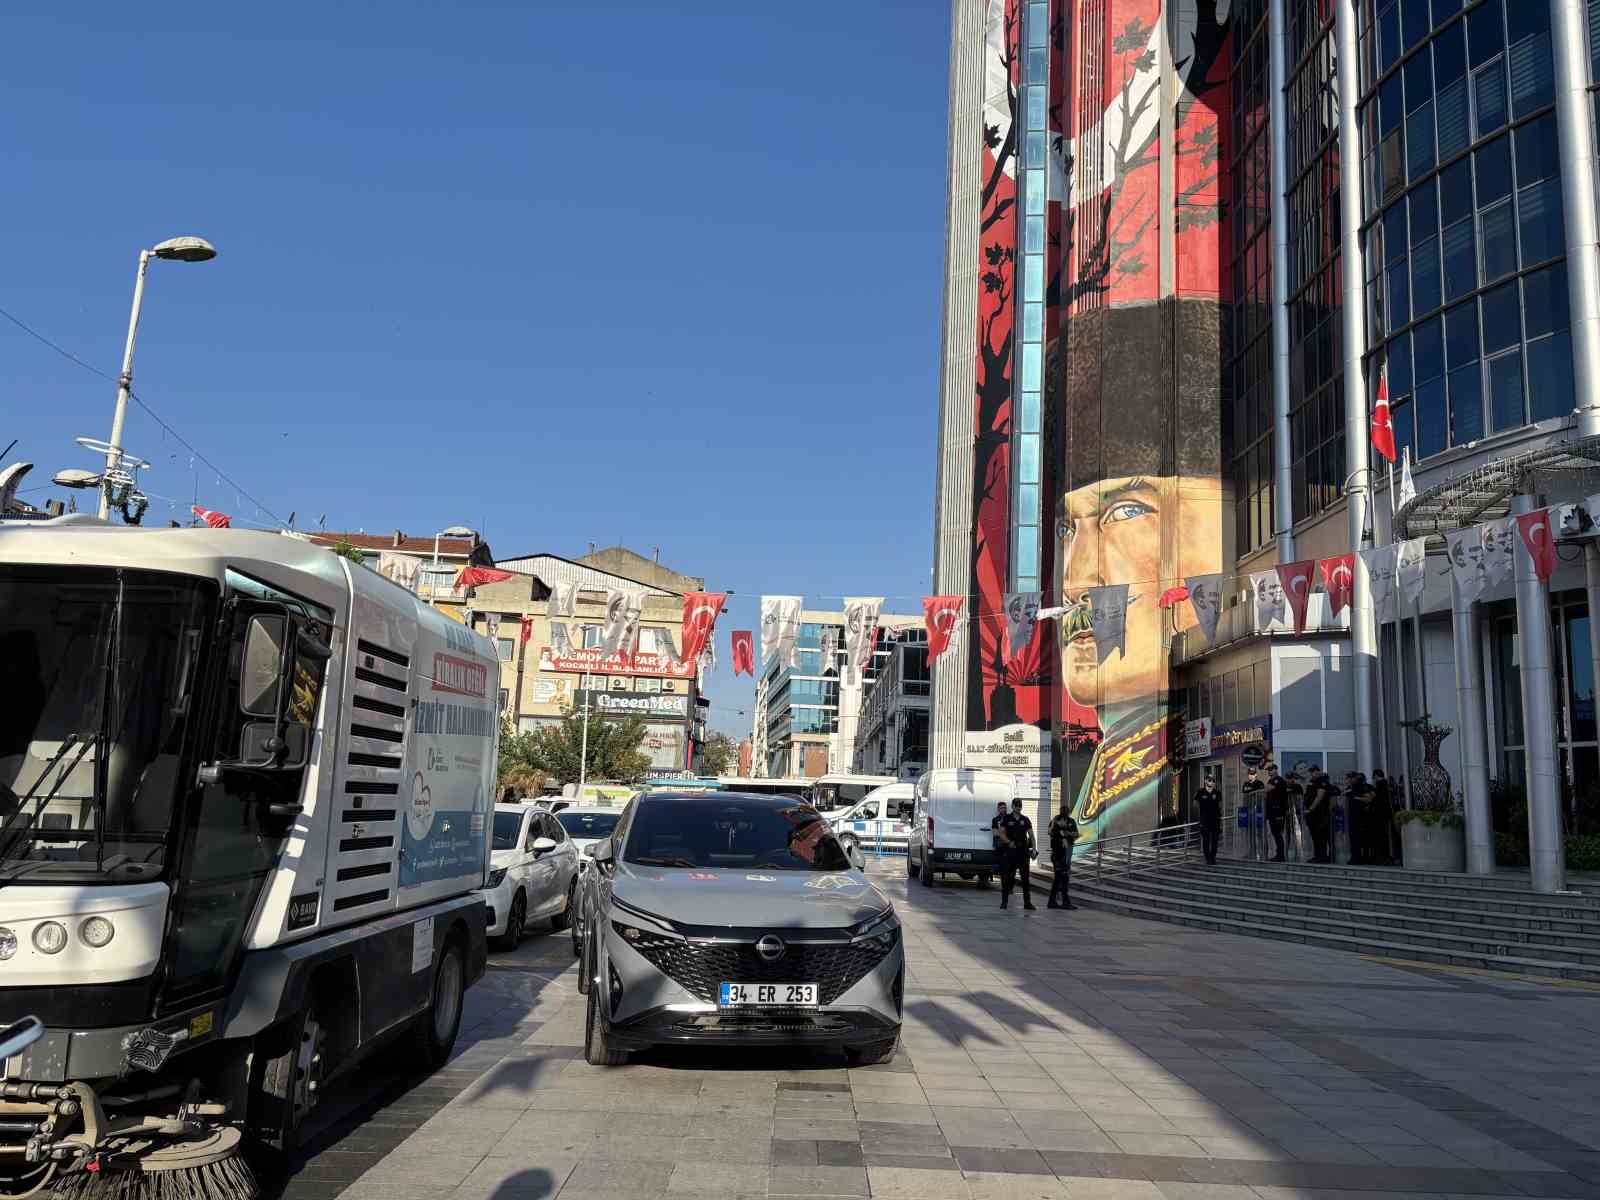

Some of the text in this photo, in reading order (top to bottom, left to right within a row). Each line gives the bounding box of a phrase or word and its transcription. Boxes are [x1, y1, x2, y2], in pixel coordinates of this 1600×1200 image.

[598, 694, 682, 710] GreenMed
[730, 985, 813, 1003] 34 ER 253
